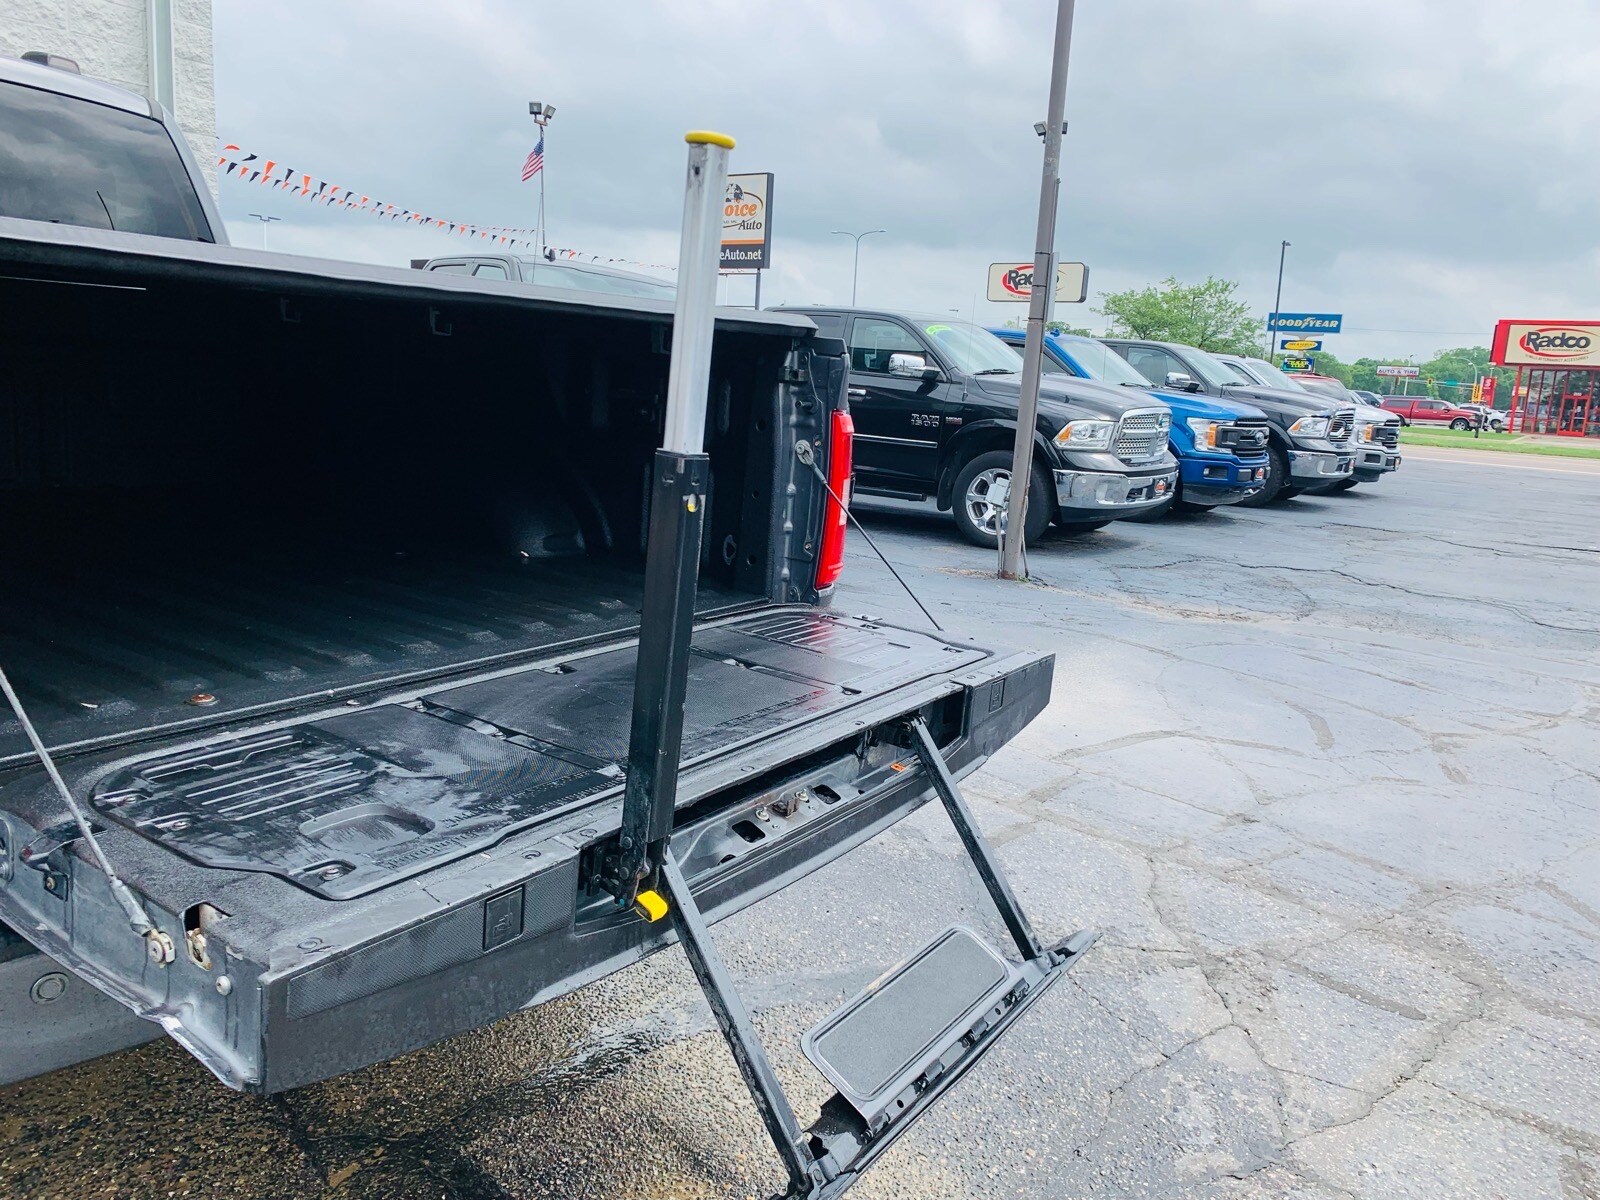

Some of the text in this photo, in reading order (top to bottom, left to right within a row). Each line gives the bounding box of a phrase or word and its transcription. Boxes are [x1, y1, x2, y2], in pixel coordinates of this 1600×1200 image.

[724, 203, 758, 217] oice
[738, 219, 763, 230] Auto
[720, 249, 762, 260] eAuto.net
[1270, 318, 1339, 329] GOODYEAR
[1525, 331, 1591, 352] Radco
[911, 413, 940, 421] RAM
[911, 419, 940, 427] 1500
